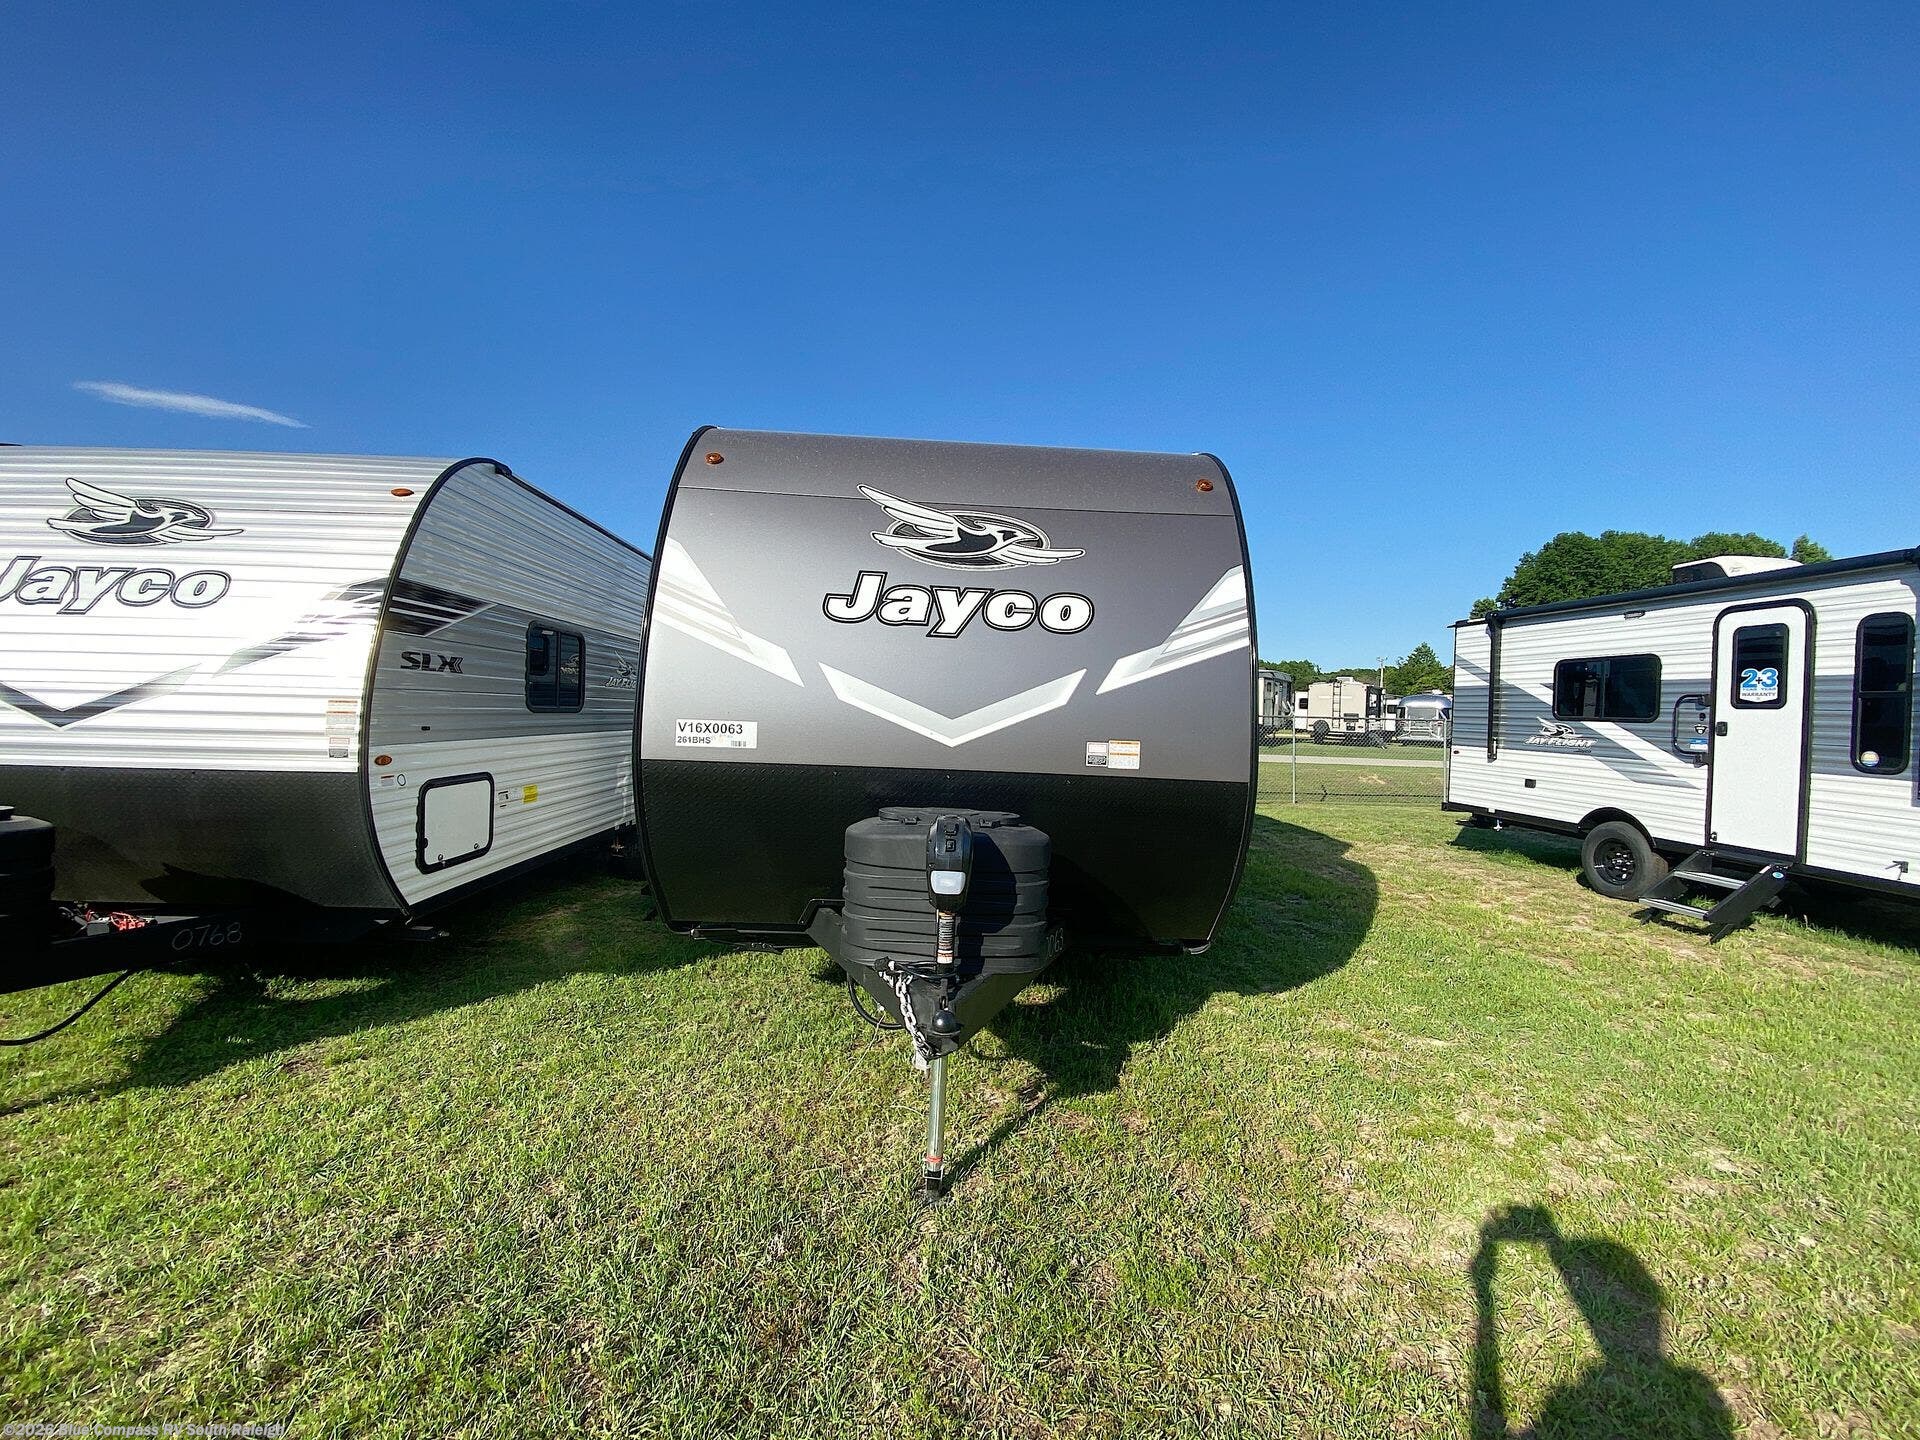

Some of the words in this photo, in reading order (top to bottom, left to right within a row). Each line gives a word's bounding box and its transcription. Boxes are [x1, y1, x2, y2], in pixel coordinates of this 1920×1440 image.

[0, 555, 232, 615] Jayco
[822, 570, 1095, 638] Jayco
[400, 651, 464, 674] SLX
[621, 678, 637, 688] FLIG
[678, 722, 743, 734] V16X0063
[677, 736, 711, 744] 261BHS
[1547, 738, 1598, 748] FLIGHT
[172, 921, 242, 950] 0768
